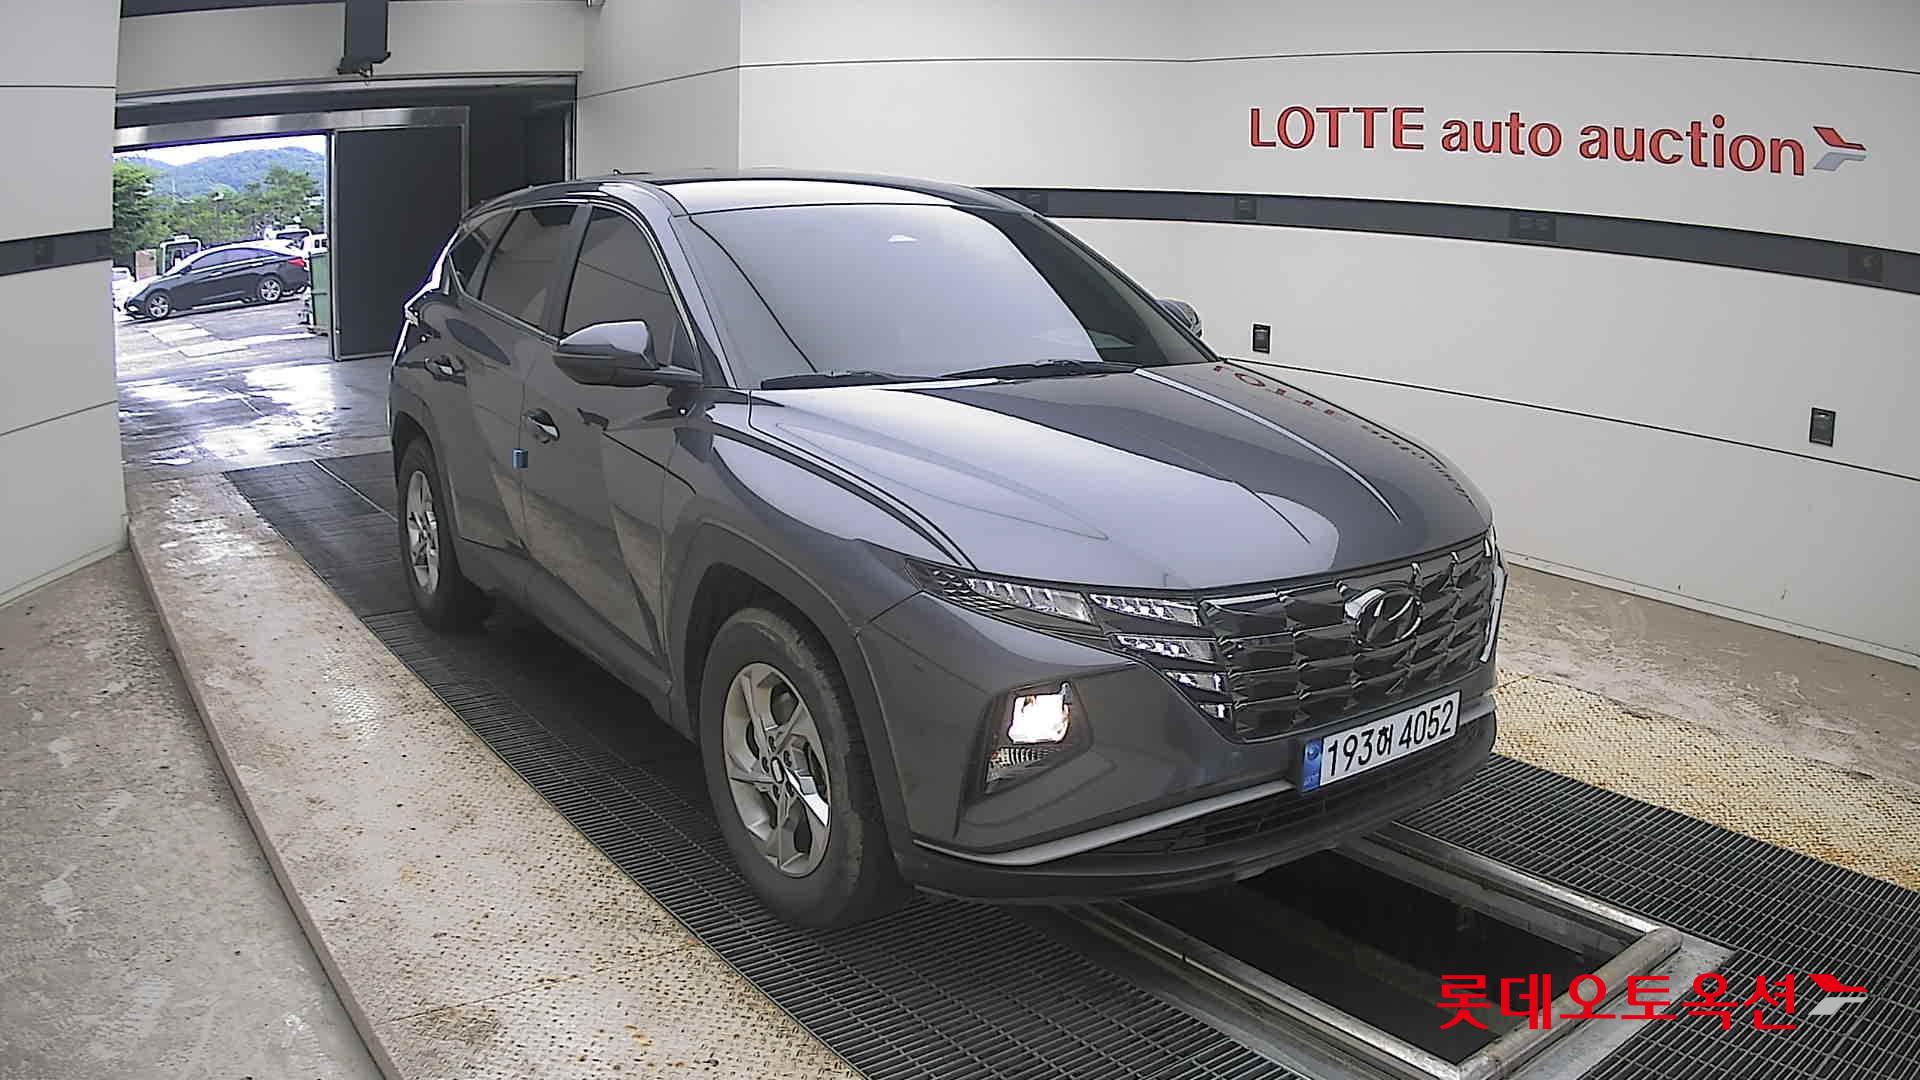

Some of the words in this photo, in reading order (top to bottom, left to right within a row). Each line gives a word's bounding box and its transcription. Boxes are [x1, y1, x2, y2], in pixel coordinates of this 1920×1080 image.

[1249, 105, 1425, 150] LOTTE
[1440, 112, 1563, 157] auto
[1578, 114, 1806, 177] auction
[1327, 723, 1394, 777] 193허
[1398, 699, 1454, 750] 4052
